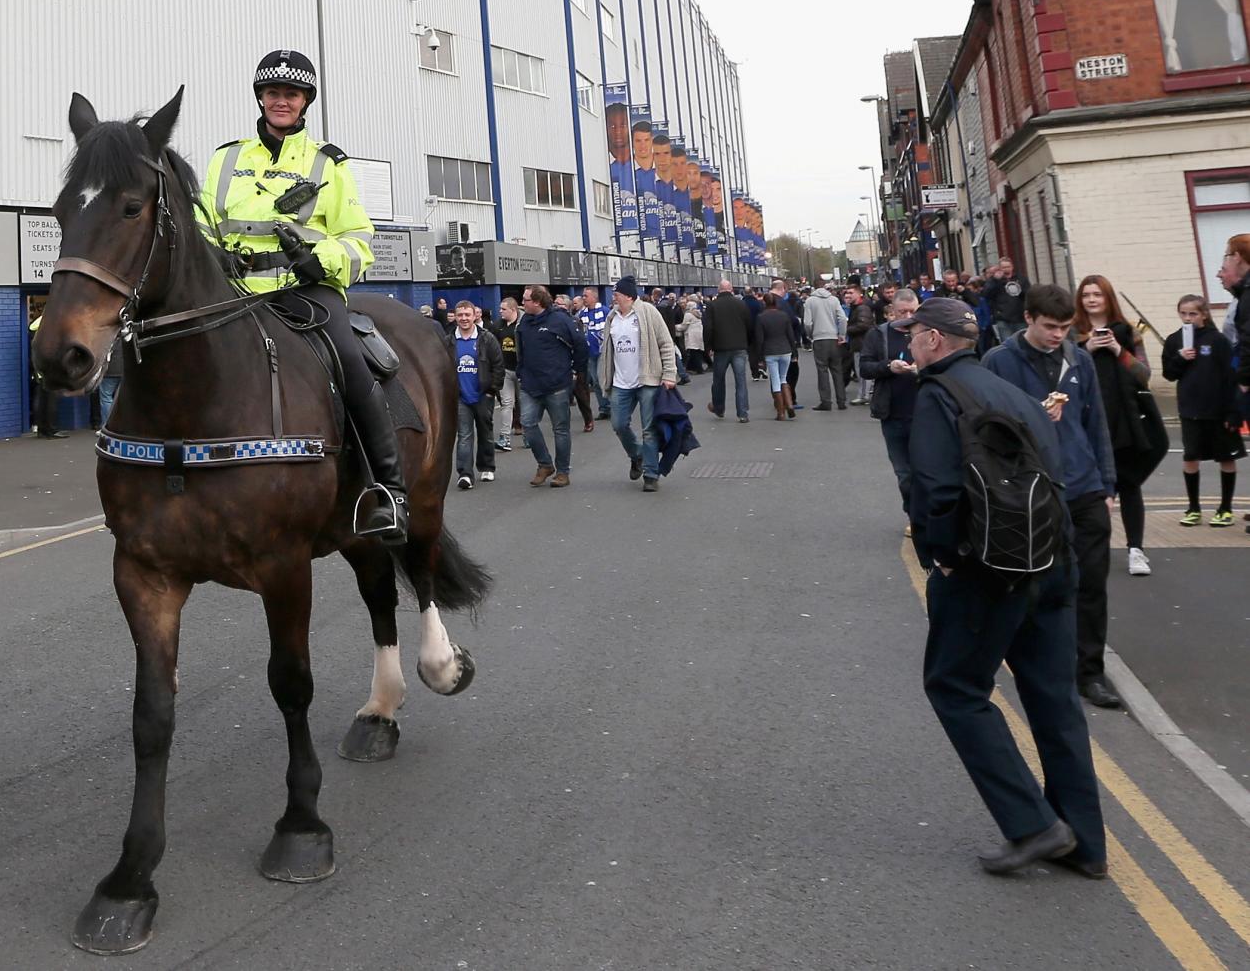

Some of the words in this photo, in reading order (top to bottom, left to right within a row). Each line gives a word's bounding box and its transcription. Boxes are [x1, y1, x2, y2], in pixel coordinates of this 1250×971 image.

[1079, 57, 1123, 70] NESTON
[1081, 66, 1125, 78] STREET
[41, 221, 61, 229] BALCO
[32, 244, 52, 252] SEATS
[31, 260, 55, 268] TURNST
[498, 256, 519, 271] EVERTON
[520, 258, 540, 272] RECEPTION
[34, 269, 43, 278] 14
[457, 365, 478, 375] Chang
[127, 445, 165, 460] POLIC
